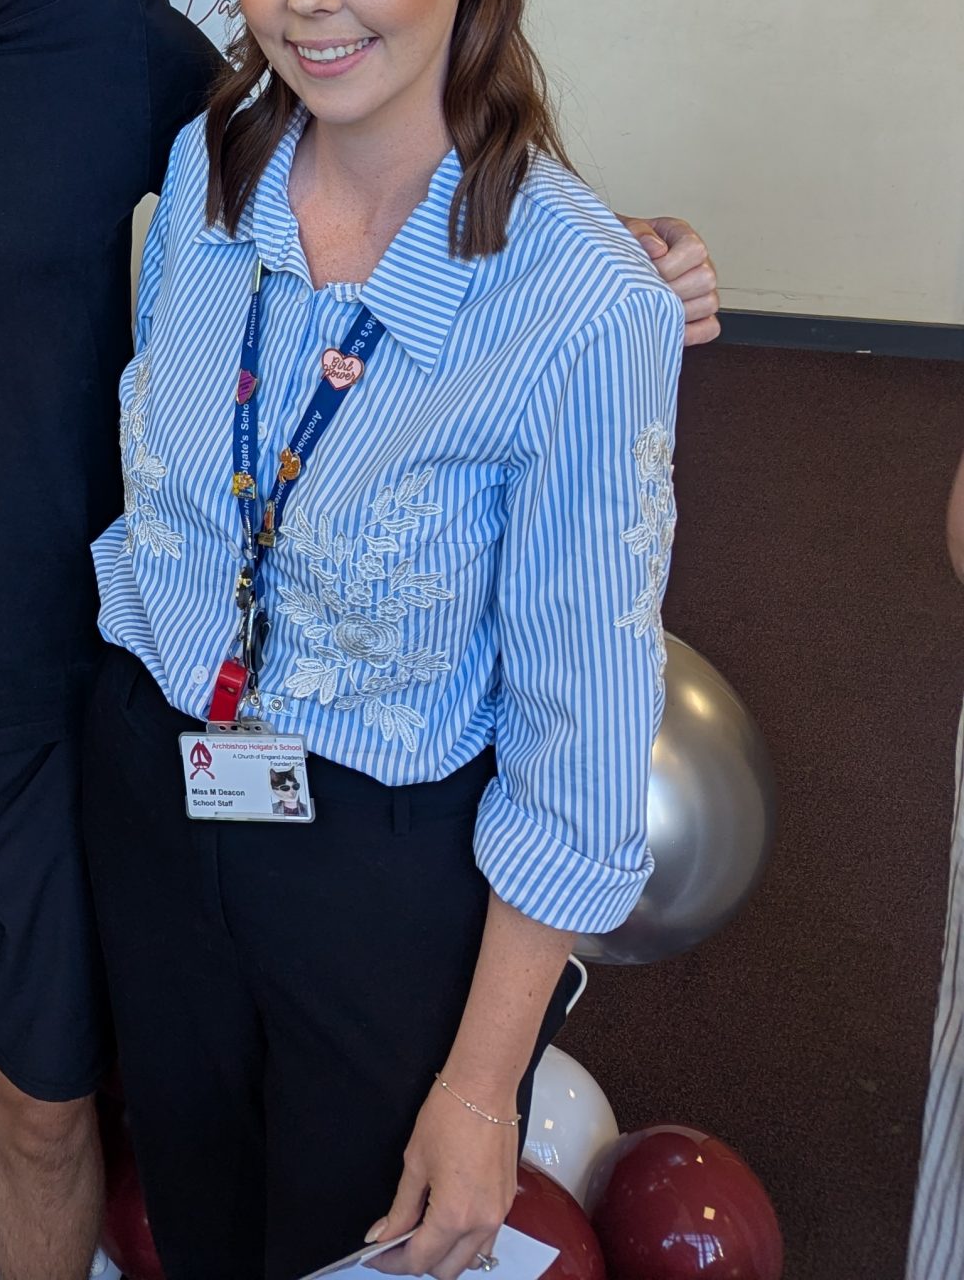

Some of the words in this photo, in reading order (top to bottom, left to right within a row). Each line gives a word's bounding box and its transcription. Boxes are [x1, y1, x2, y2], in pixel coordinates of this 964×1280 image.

[212, 743, 247, 751] Archbishop
[249, 743, 278, 752] Holgate's
[279, 743, 302, 751] School
[209, 788, 217, 796] M
[218, 789, 246, 797] Deacon
[192, 799, 216, 807] School
